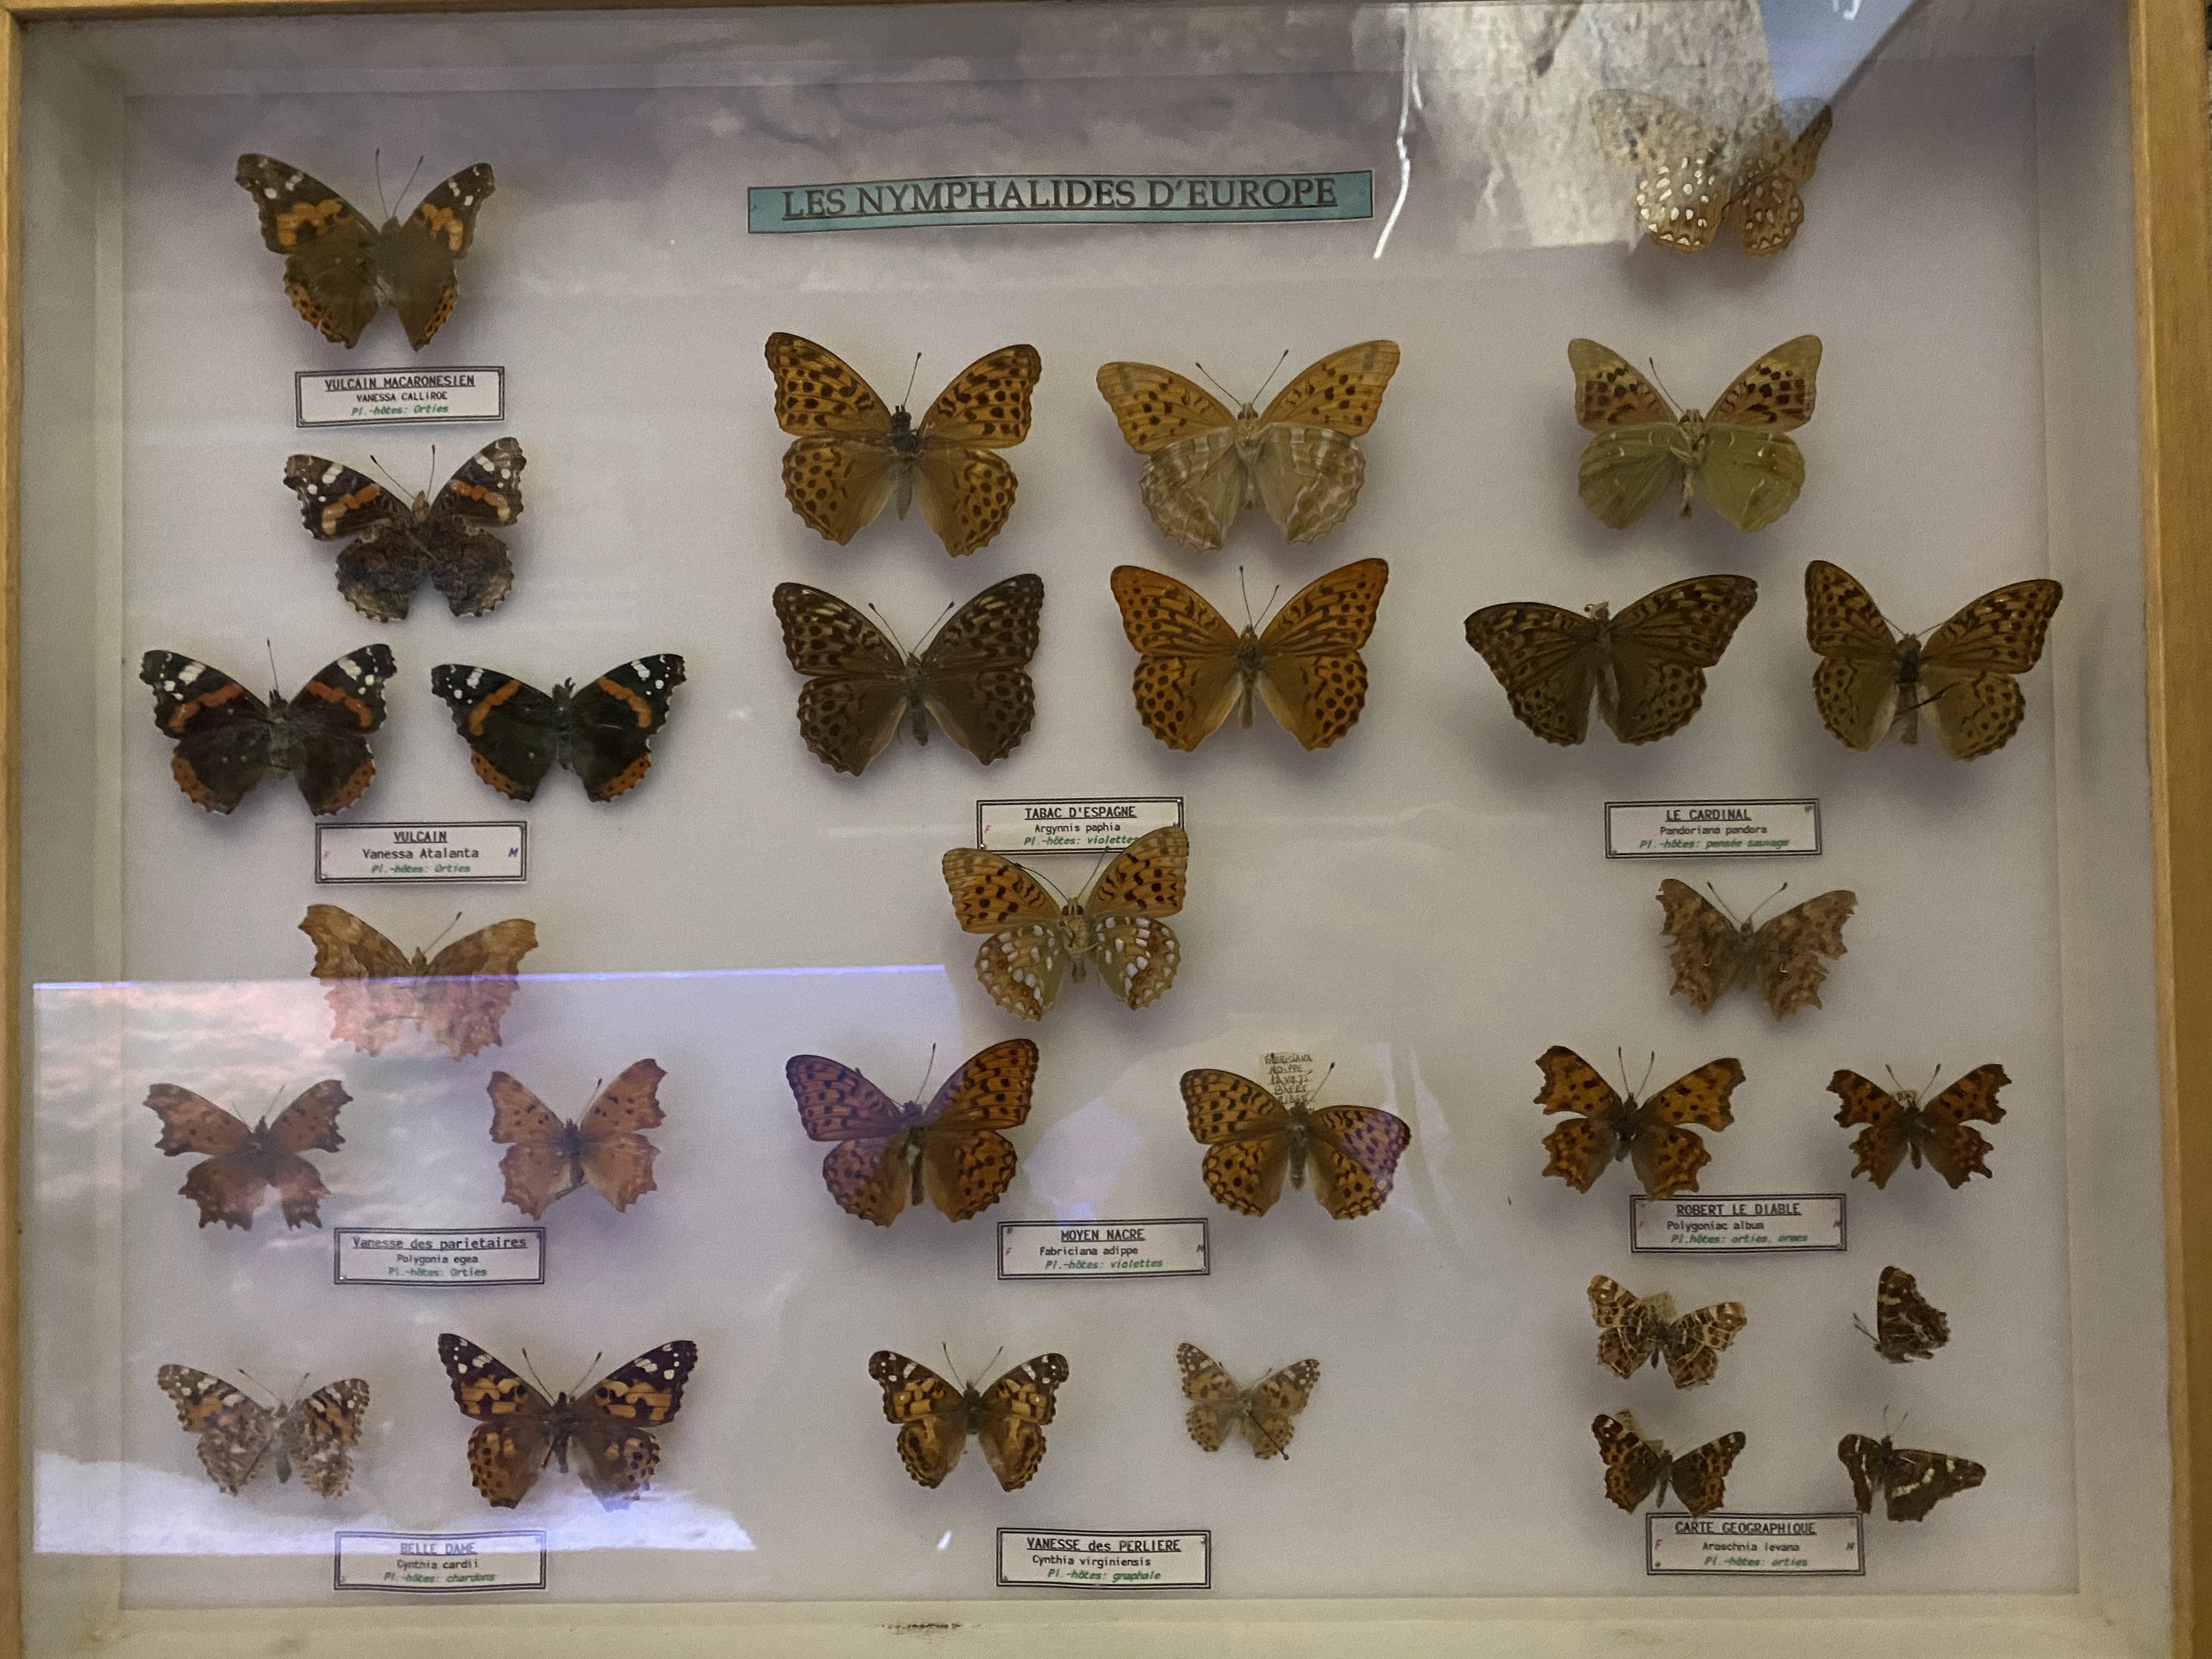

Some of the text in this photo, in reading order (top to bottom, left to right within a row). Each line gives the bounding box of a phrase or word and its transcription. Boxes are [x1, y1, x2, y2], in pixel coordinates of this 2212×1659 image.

[782, 177, 1338, 219] LES NYMPHALIDES D'EUROPE
[325, 375, 475, 391] VULCAIN MACARONESIEN
[356, 392, 447, 402] VANESSA CALLIROE
[1025, 806, 1137, 819] TABAC D'ESPAGNE
[1666, 809, 1752, 821] LE CARDINAL
[1035, 823, 1120, 834] Argynnis paphia
[1725, 825, 1767, 835] pandora
[393, 831, 447, 843] VULCAIN
[362, 848, 478, 859] Vanessa Atalanta
[1677, 1203, 1801, 1216] ROBERT LE DIABLE
[1667, 1221, 1764, 1232] Polygoniac album
[1062, 1229, 1145, 1241] MOYEN NACRE
[353, 1236, 527, 1249] Vanesse des parietaires
[1040, 1246, 1138, 1257] Fabriciana adippe
[454, 1255, 478, 1265] egea
[1675, 1522, 1816, 1534] CARTE GEOGRAPHIQUE
[400, 1542, 477, 1554] BELLE DAME
[1027, 1538, 1181, 1552] VANESSE des PERLIERE
[1765, 1542, 1800, 1551] levana
[397, 1559, 437, 1570] Cynthia
[1032, 1555, 1151, 1568] Cynthia virginiensis
